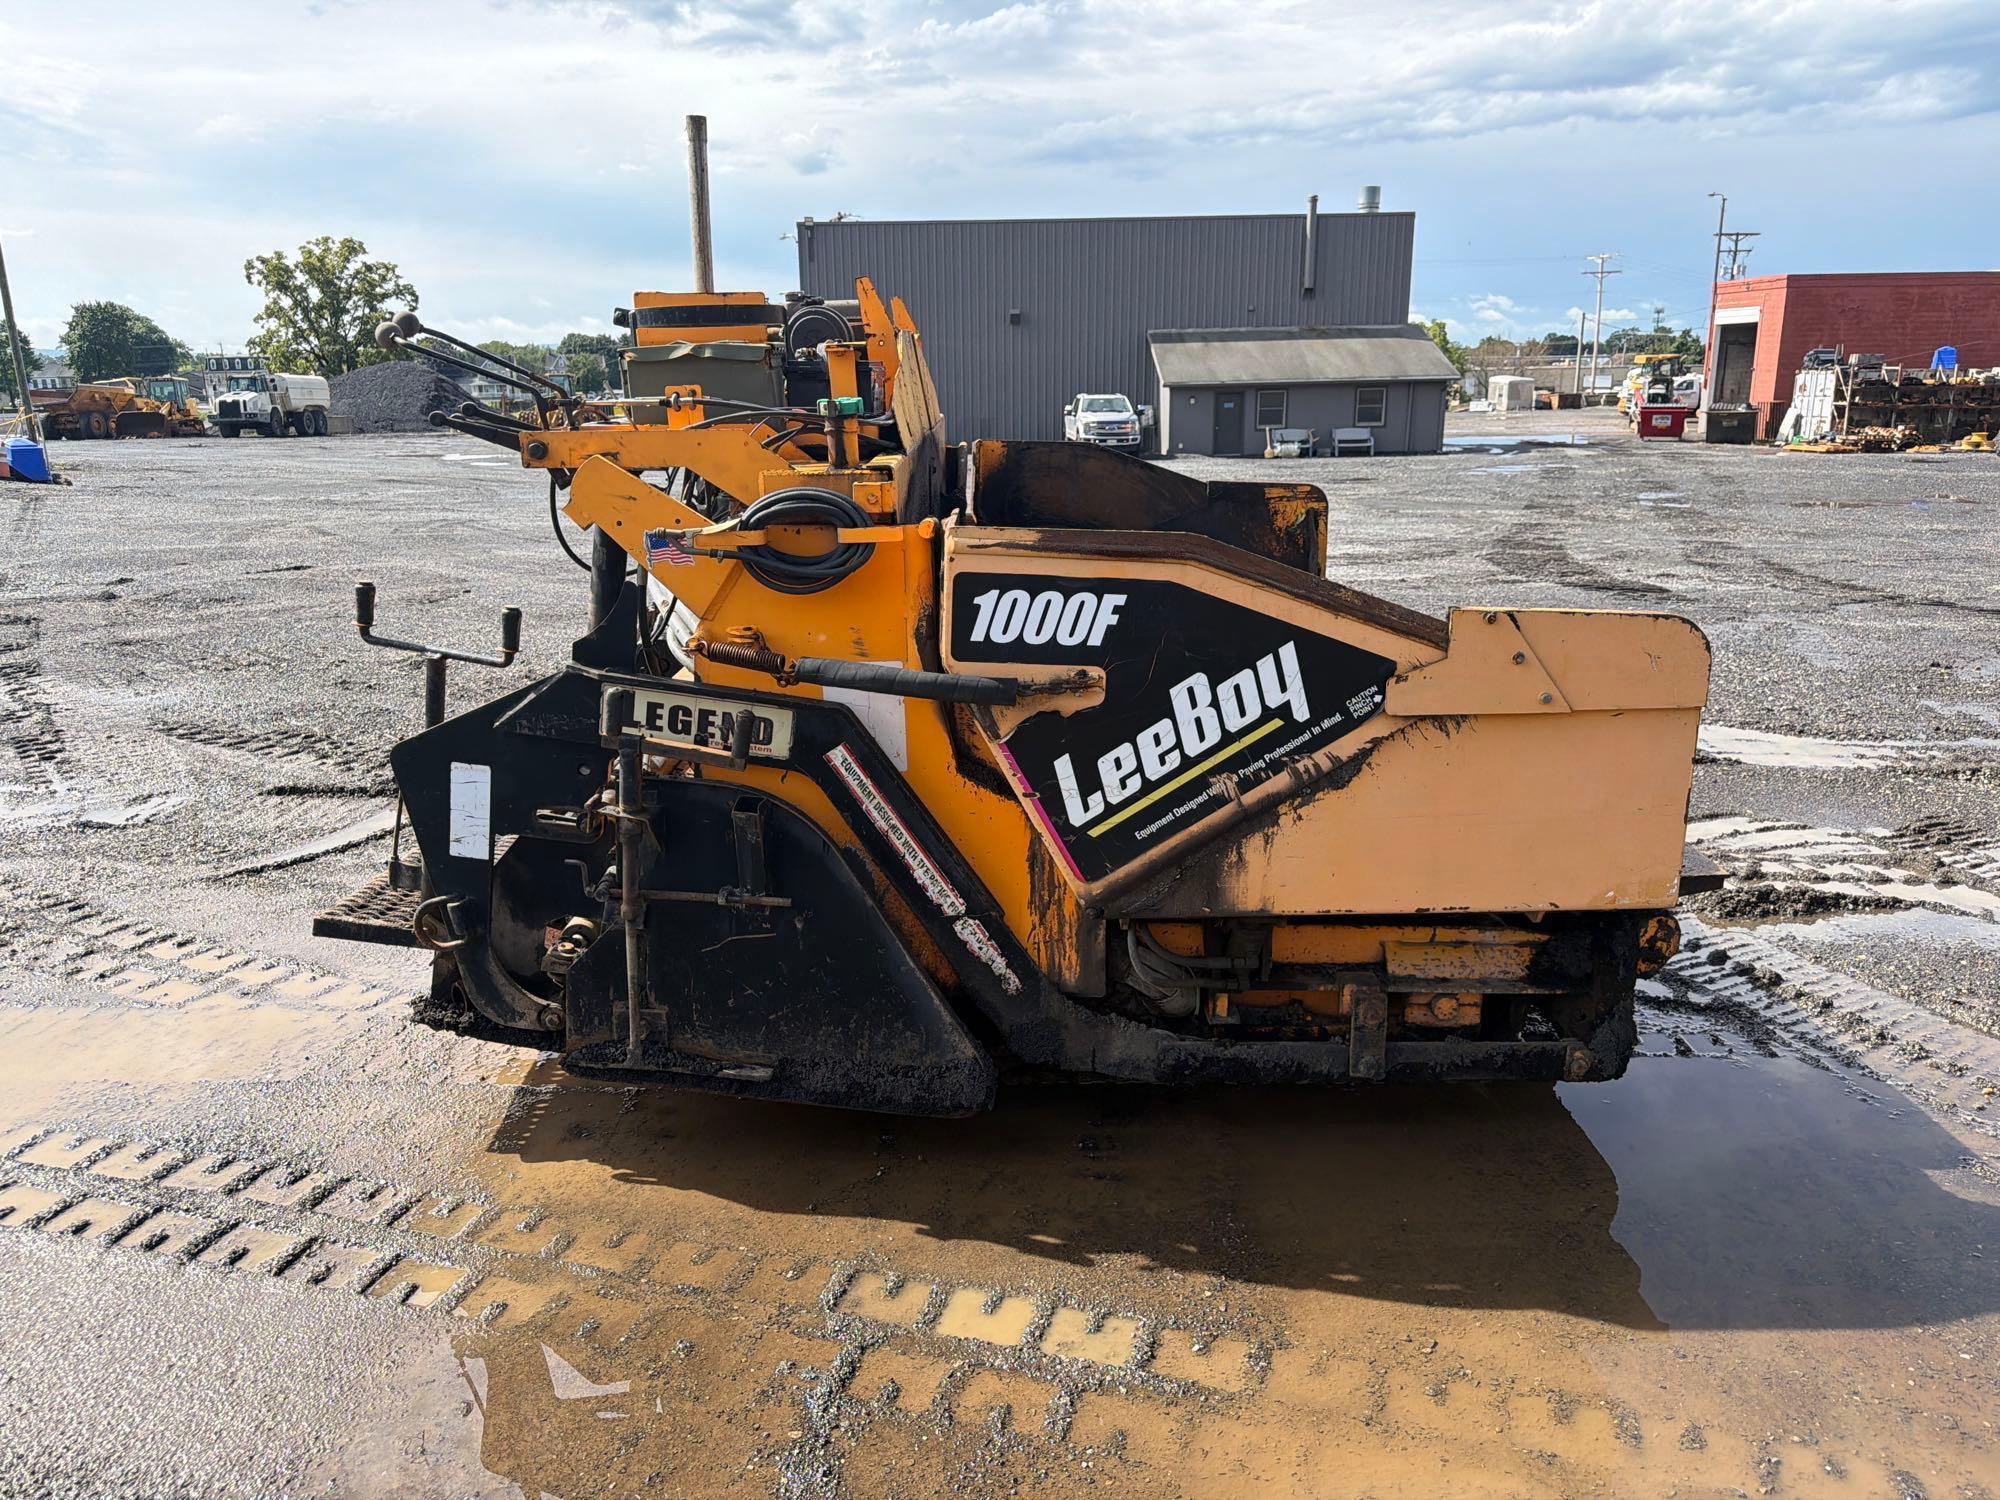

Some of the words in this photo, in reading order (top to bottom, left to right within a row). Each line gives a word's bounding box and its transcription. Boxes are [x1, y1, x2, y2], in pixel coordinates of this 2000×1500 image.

[969, 589, 1127, 646] 1000F
[621, 690, 774, 745] LEGEND
[1345, 684, 1378, 707] CAUTION
[1349, 696, 1372, 713] PINCH
[1352, 702, 1375, 719] POINT
[1053, 640, 1311, 828] LeeBoy
[1134, 811, 1175, 841] Equipment
[1172, 790, 1209, 818] Designed
[1237, 757, 1266, 778] Paving
[1263, 729, 1312, 763] Professional
[1311, 724, 1322, 735] In
[1319, 710, 1344, 730] Mind.
[871, 801, 905, 841] DESIGNED
[899, 837, 920, 861] WITH
